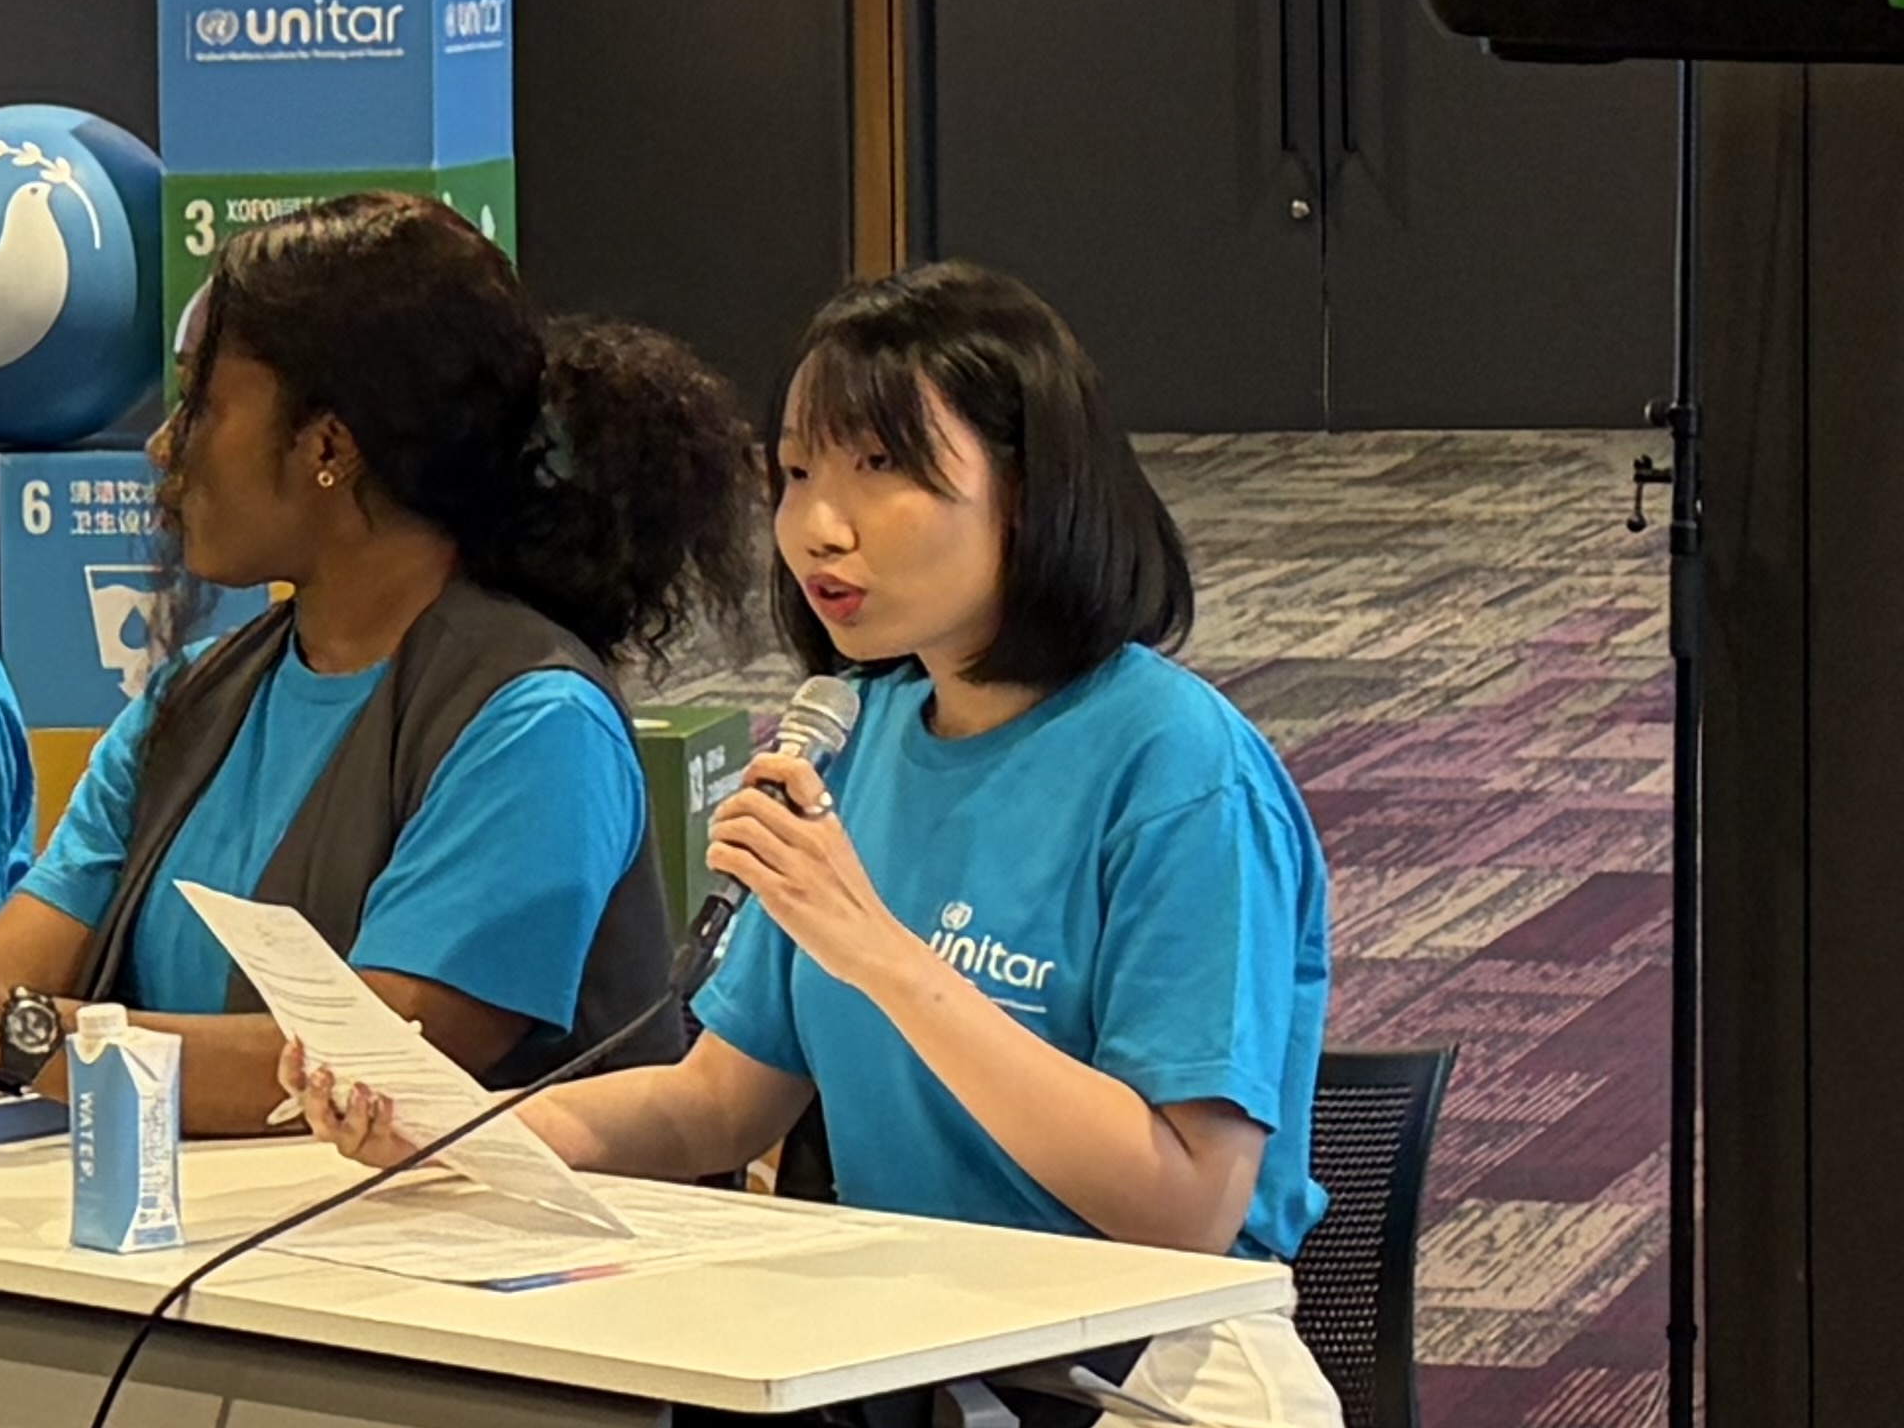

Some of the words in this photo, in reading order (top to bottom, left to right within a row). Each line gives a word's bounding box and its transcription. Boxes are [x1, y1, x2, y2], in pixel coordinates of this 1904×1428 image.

[185, 199, 215, 256] 3
[22, 480, 51, 535] 6
[929, 929, 1055, 990] unitar
